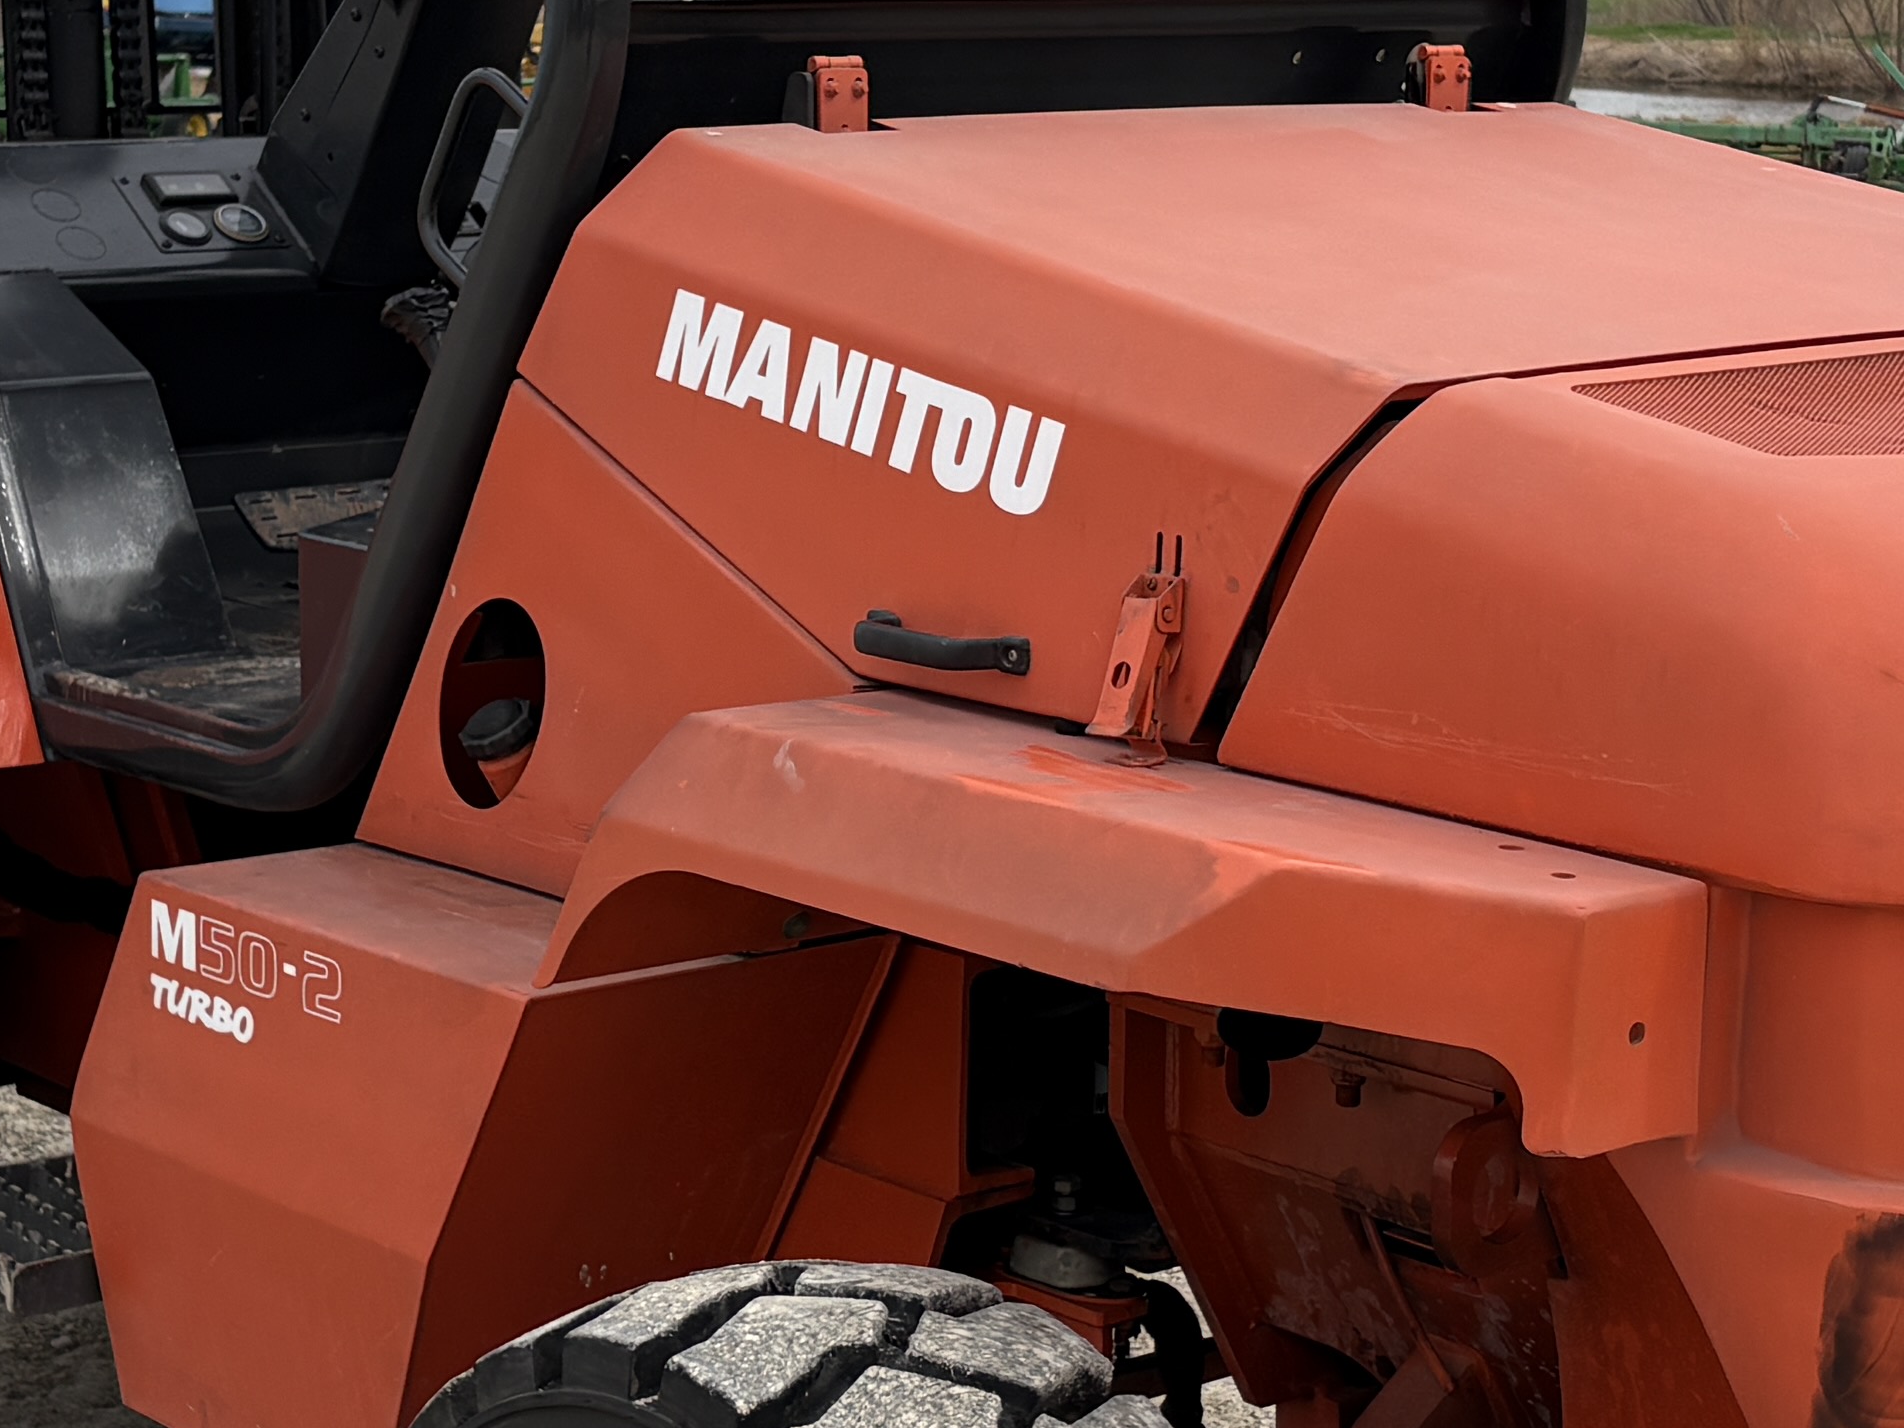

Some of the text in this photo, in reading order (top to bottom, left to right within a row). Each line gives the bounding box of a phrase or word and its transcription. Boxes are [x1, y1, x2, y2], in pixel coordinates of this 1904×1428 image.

[655, 288, 1066, 516] MANITOU
[150, 973, 254, 1044] TURBO
[151, 898, 343, 1024] M50-2
